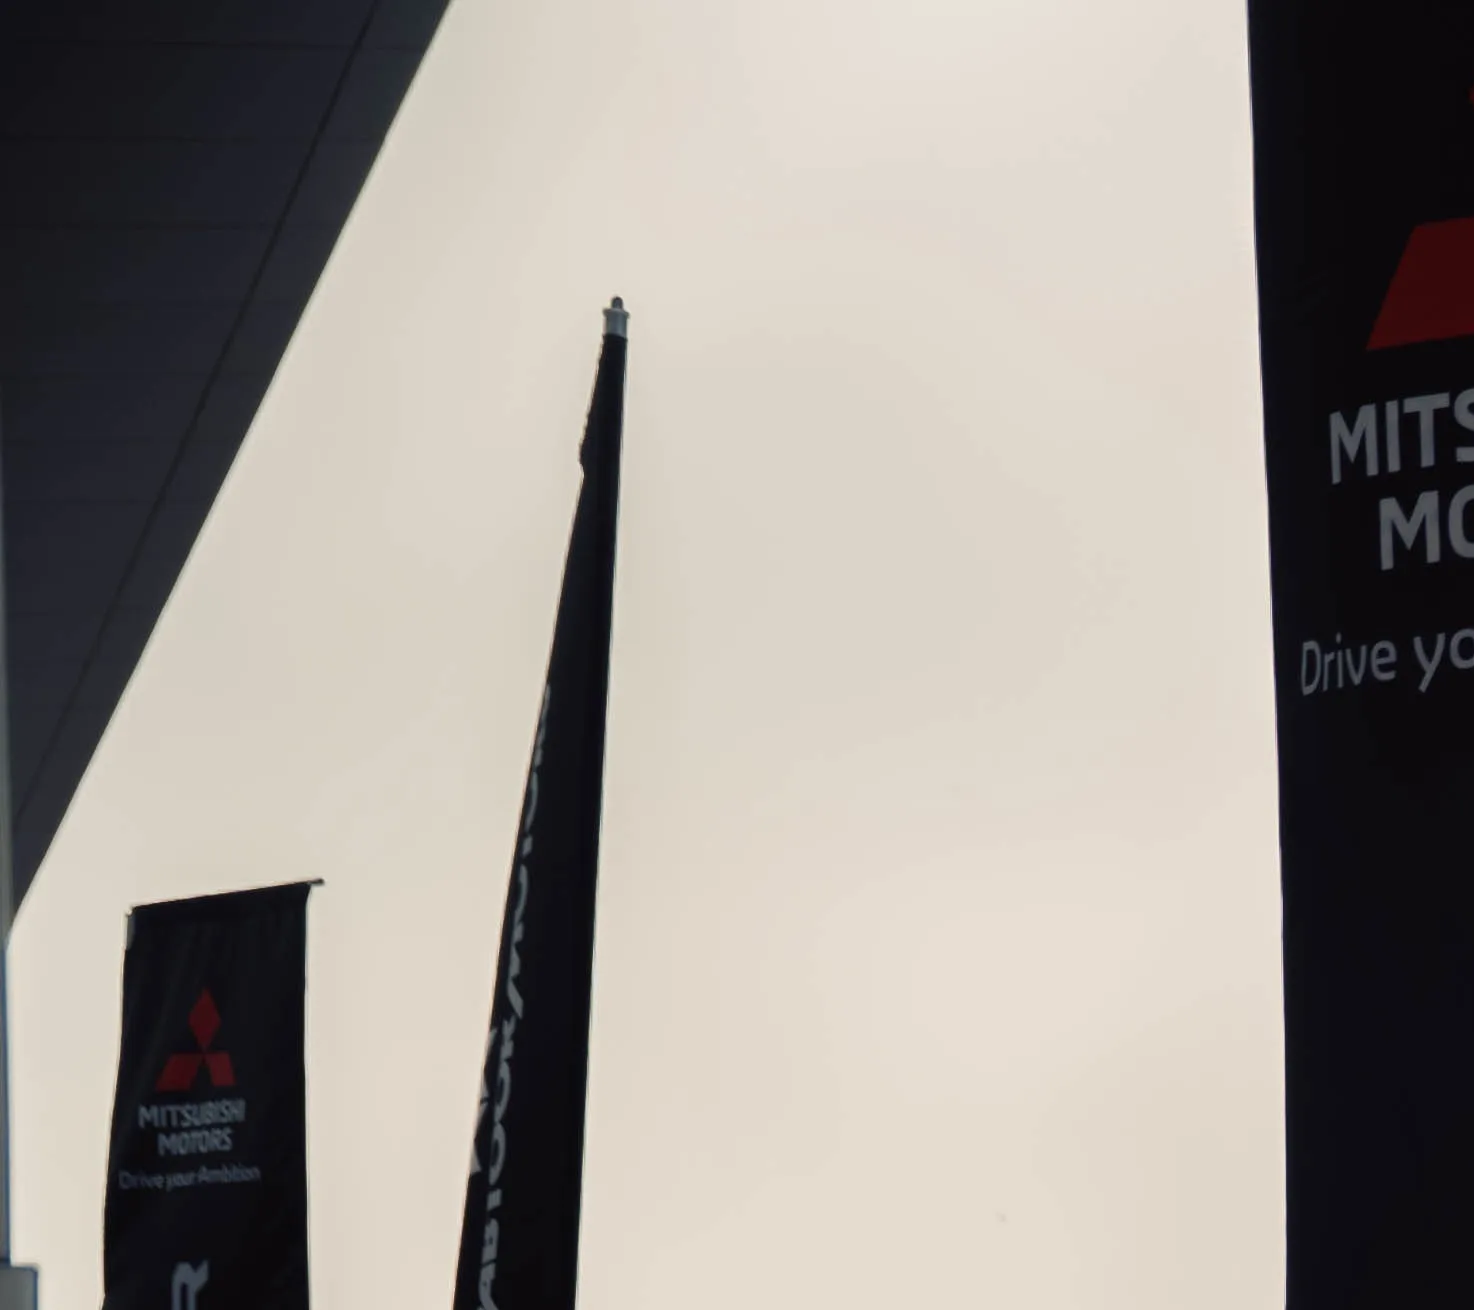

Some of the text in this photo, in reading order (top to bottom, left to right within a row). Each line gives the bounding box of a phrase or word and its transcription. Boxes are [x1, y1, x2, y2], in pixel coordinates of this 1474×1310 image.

[1302, 636, 1397, 695] Drive
[137, 1097, 246, 1129] MITSUBISHI
[157, 1126, 233, 1156] MOTORS
